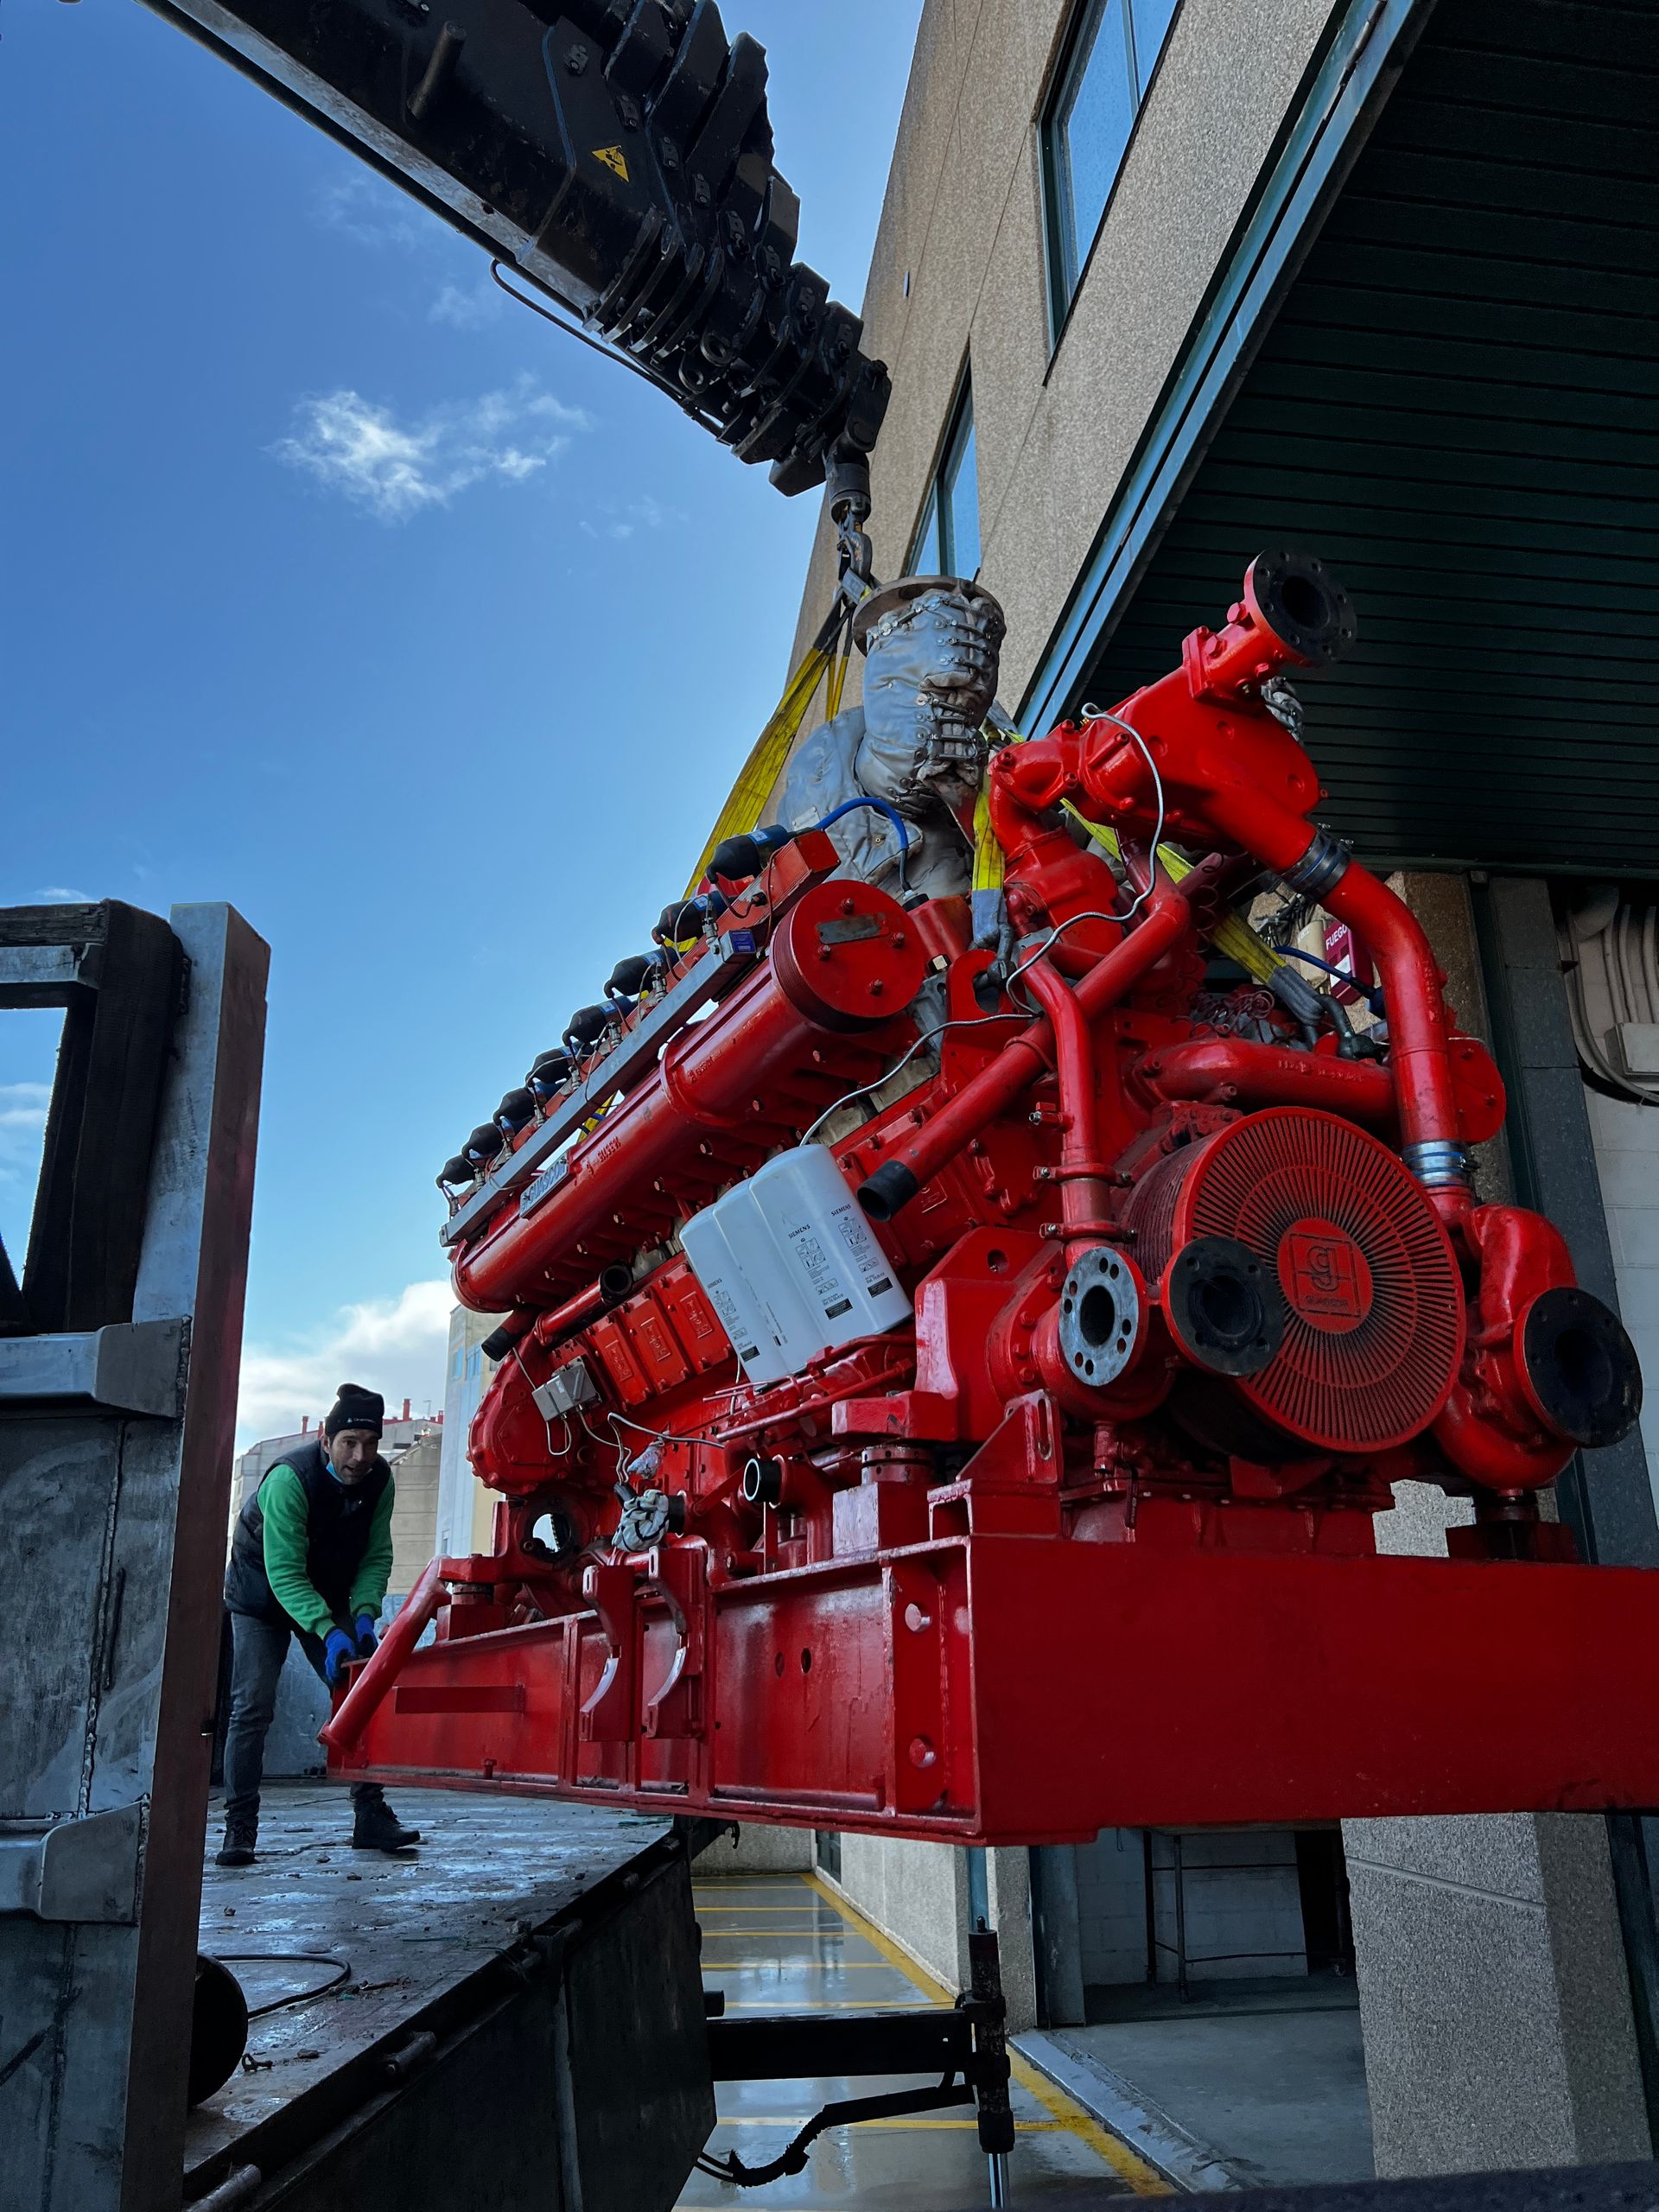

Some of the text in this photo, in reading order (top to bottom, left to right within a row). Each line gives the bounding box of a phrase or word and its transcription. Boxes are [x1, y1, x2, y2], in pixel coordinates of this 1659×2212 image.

[1325, 924, 1348, 950] FUEGO
[830, 1204, 851, 1217] SIEMENS
[788, 1224, 810, 1239] SIEMENS
